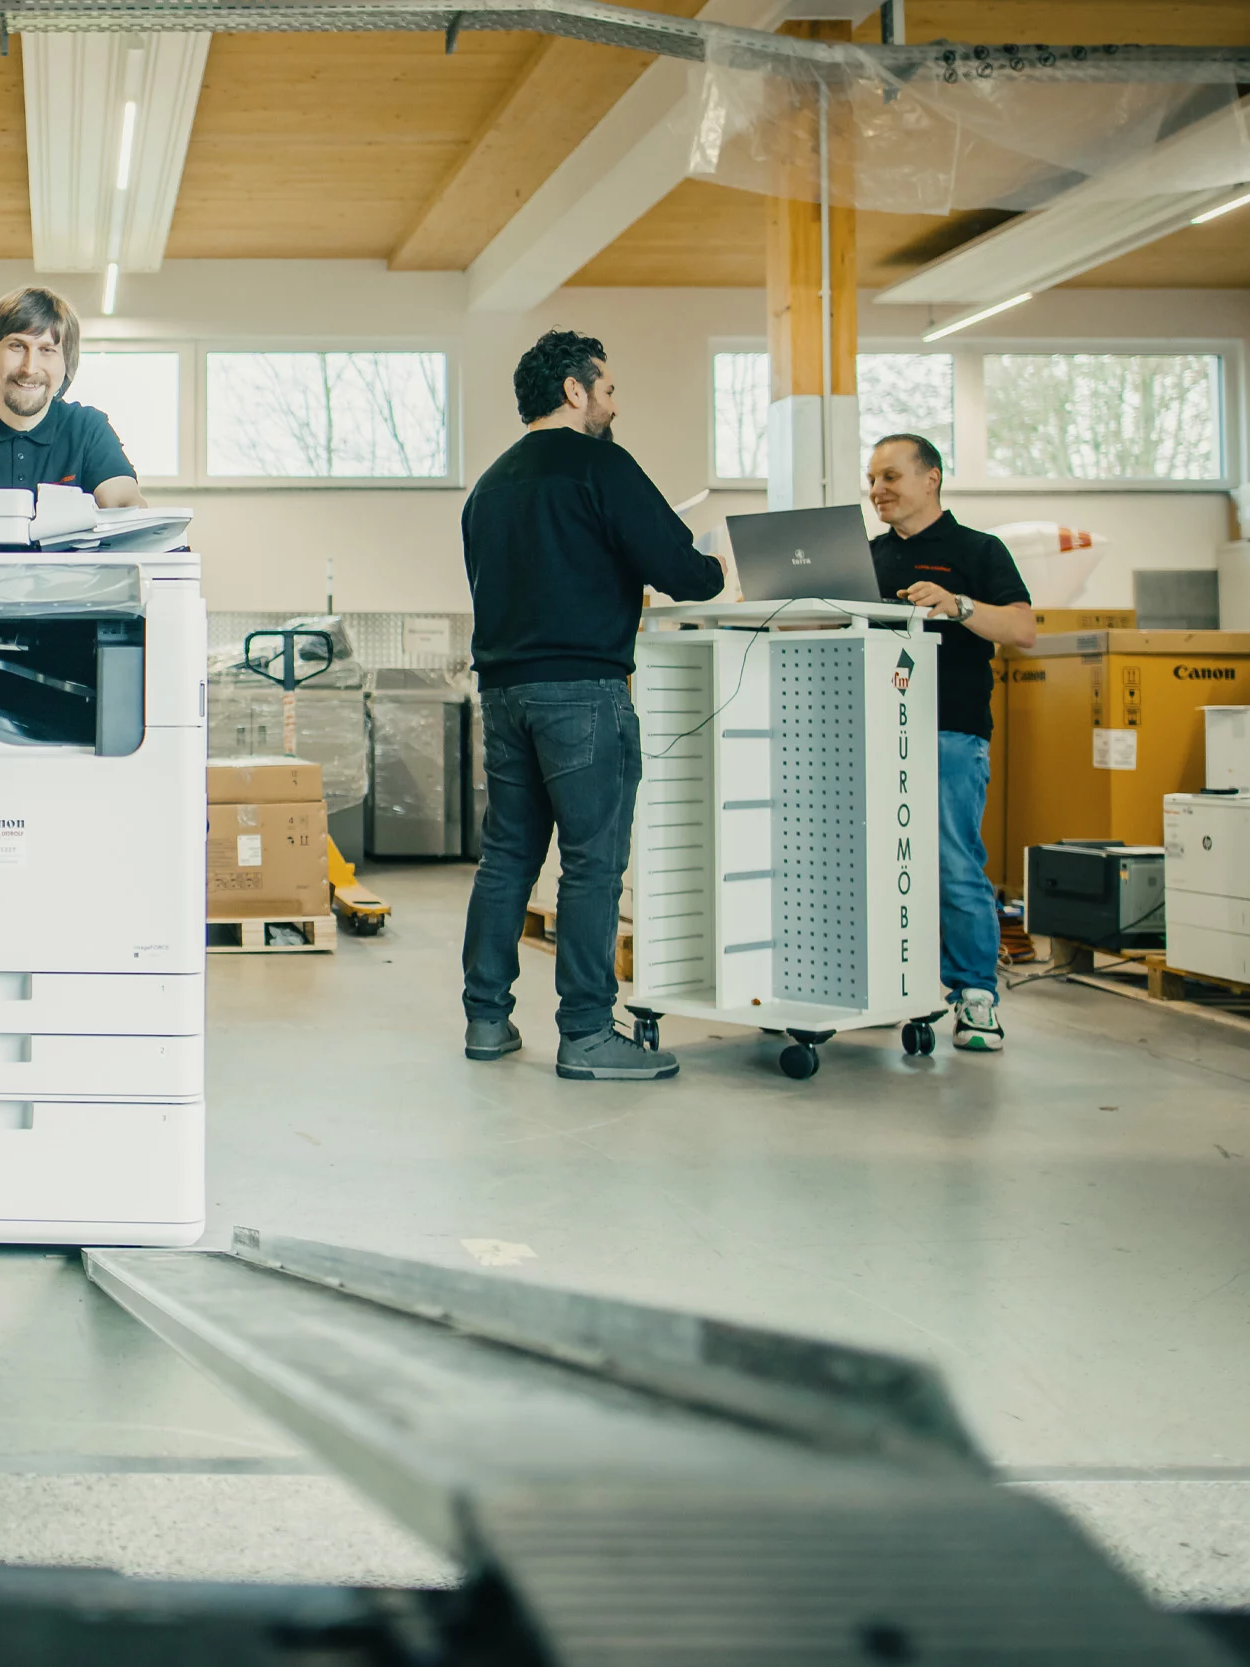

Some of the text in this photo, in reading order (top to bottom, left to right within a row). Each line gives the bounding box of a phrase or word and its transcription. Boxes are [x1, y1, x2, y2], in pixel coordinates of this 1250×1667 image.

[1012, 668, 1046, 683] Canon
[1173, 664, 1236, 681] Canon
[897, 702, 911, 997] BÜROMÖBEL
